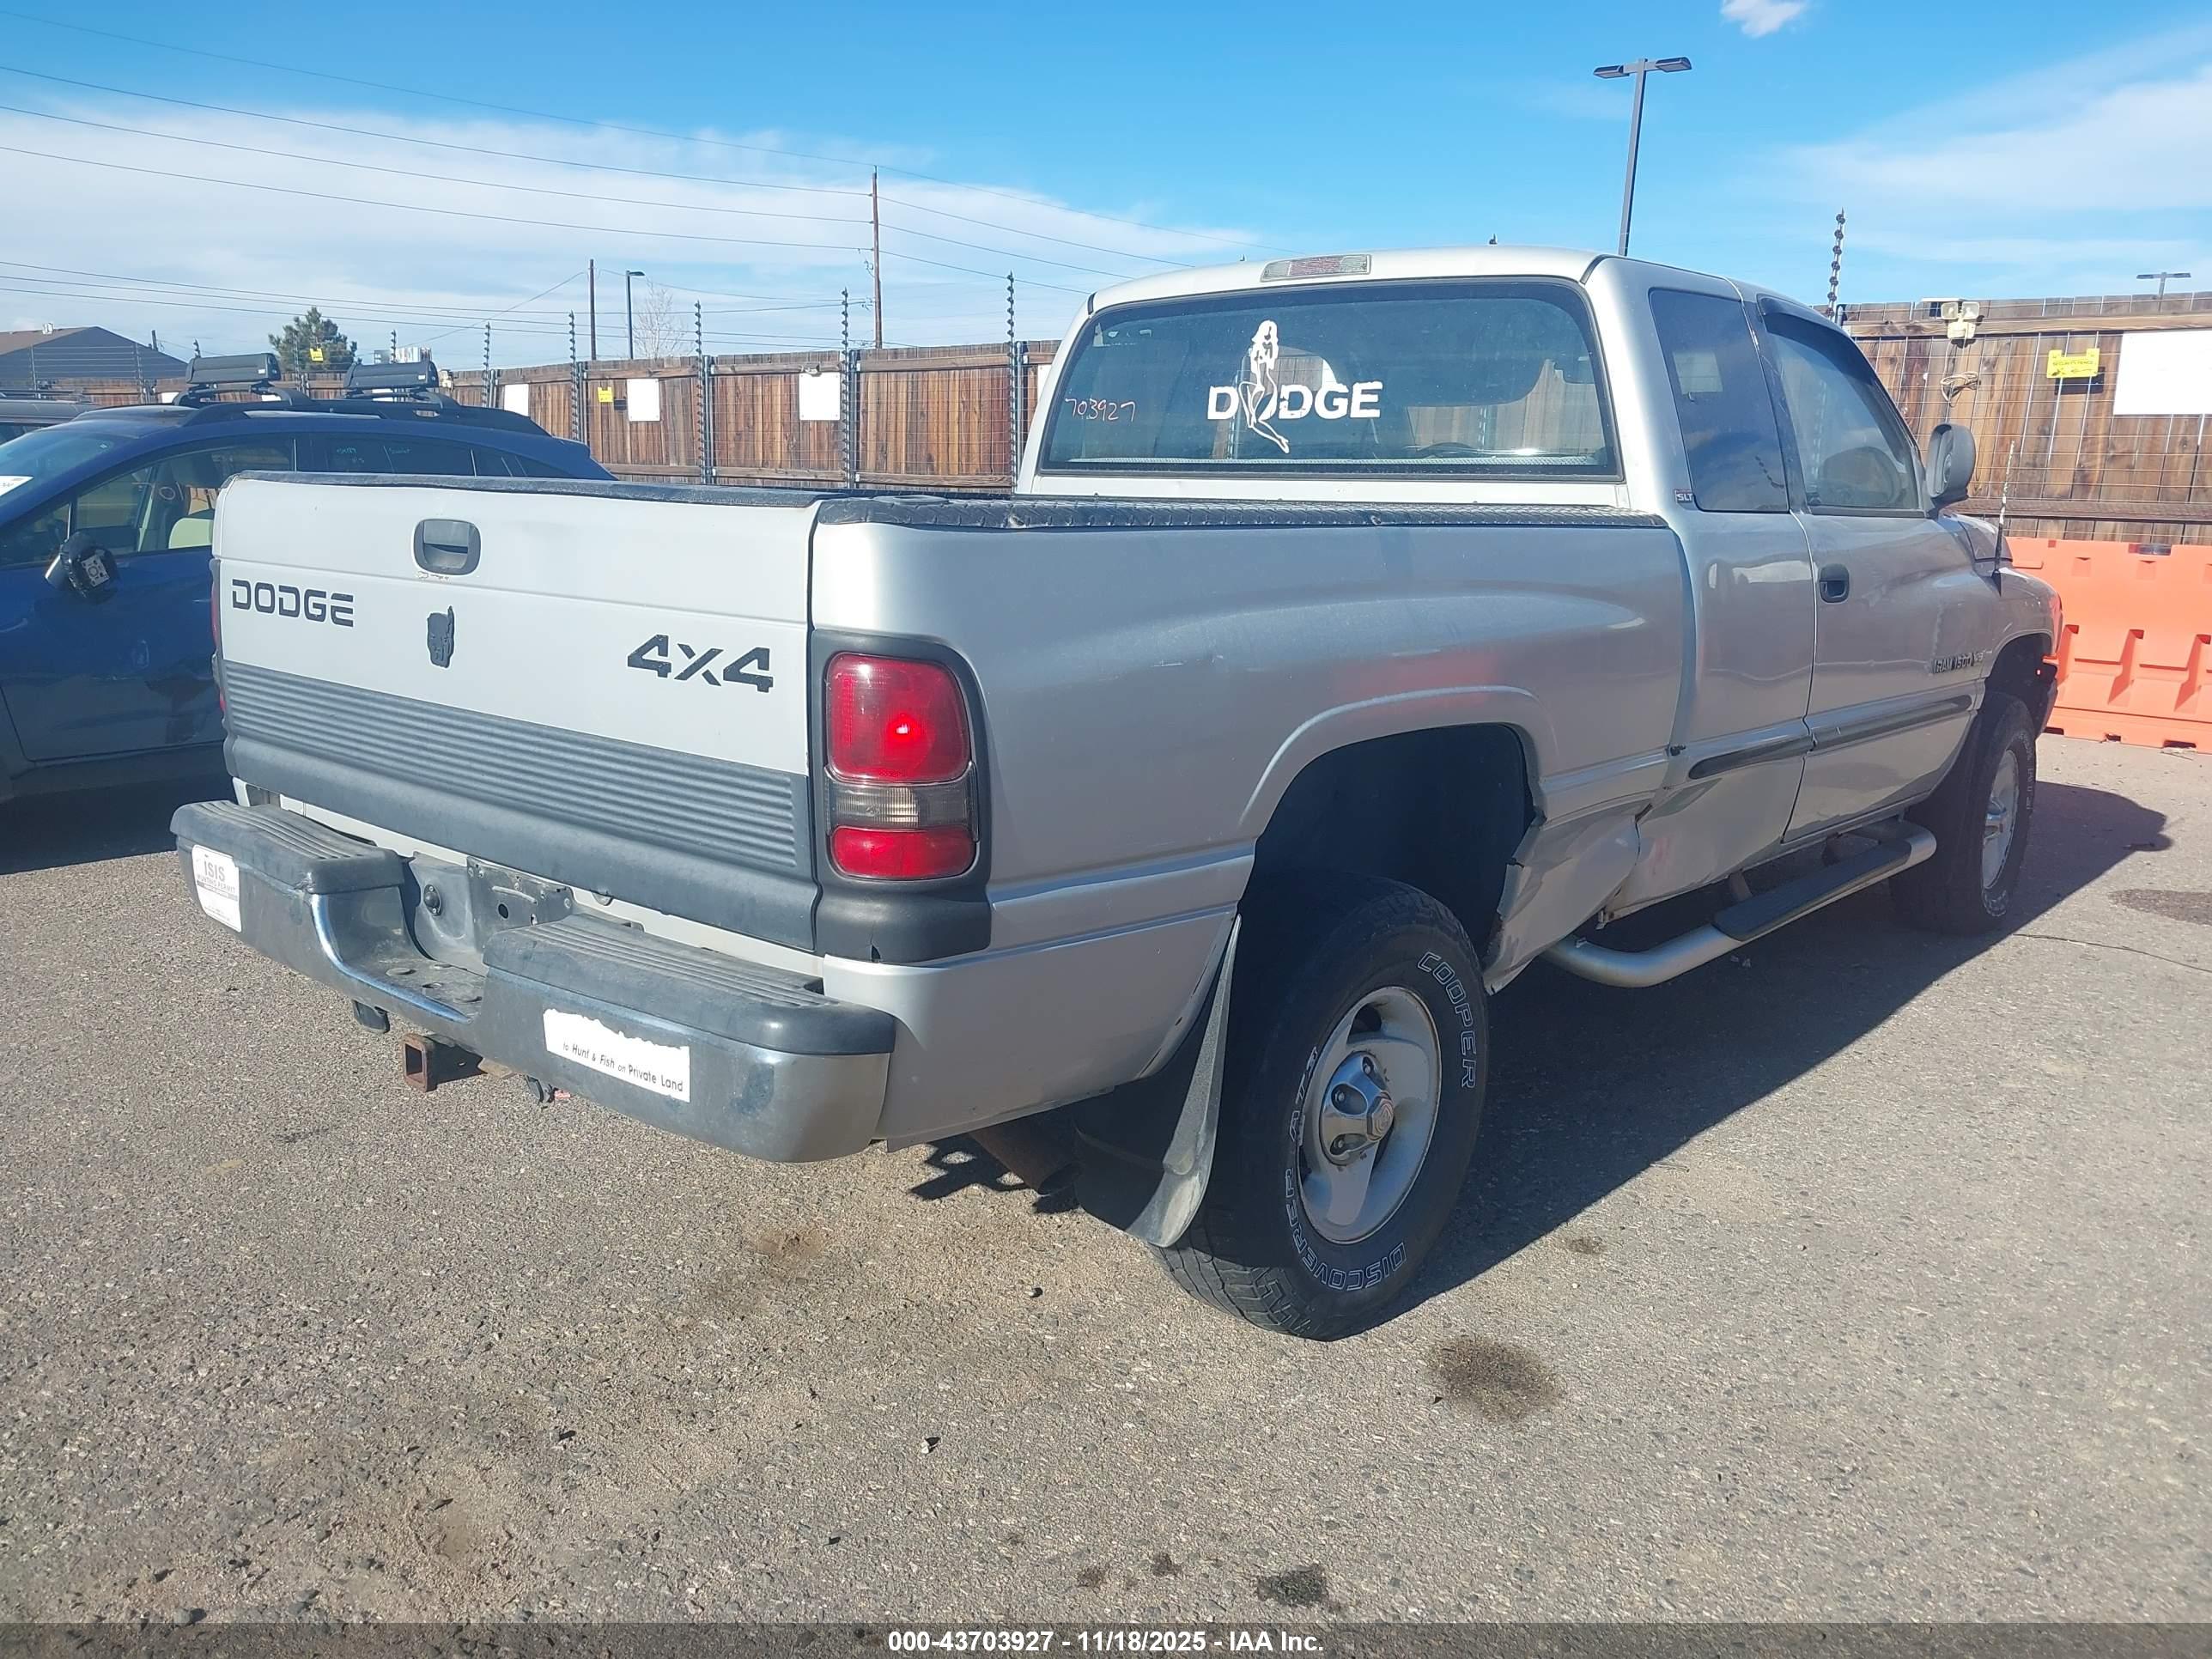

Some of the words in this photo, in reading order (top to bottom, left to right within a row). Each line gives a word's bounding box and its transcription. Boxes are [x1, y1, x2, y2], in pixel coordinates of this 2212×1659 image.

[1065, 398, 1135, 422] 703927
[1675, 493, 1692, 501] SLT
[232, 579, 354, 628] DODGE
[1933, 658, 1955, 674] RAM
[204, 860, 226, 883] ISIS
[217, 881, 236, 894] PERMIT
[1417, 951, 1478, 1091] COOPER
[562, 1041, 569, 1051] to
[572, 1043, 590, 1059] Hunt
[592, 1053, 597, 1061] &
[599, 1054, 615, 1069] Fish
[617, 1063, 626, 1073] on
[628, 1064, 657, 1084] Private
[660, 1073, 684, 1092] Land
[1285, 1167, 1408, 1292] DISCOVERER
